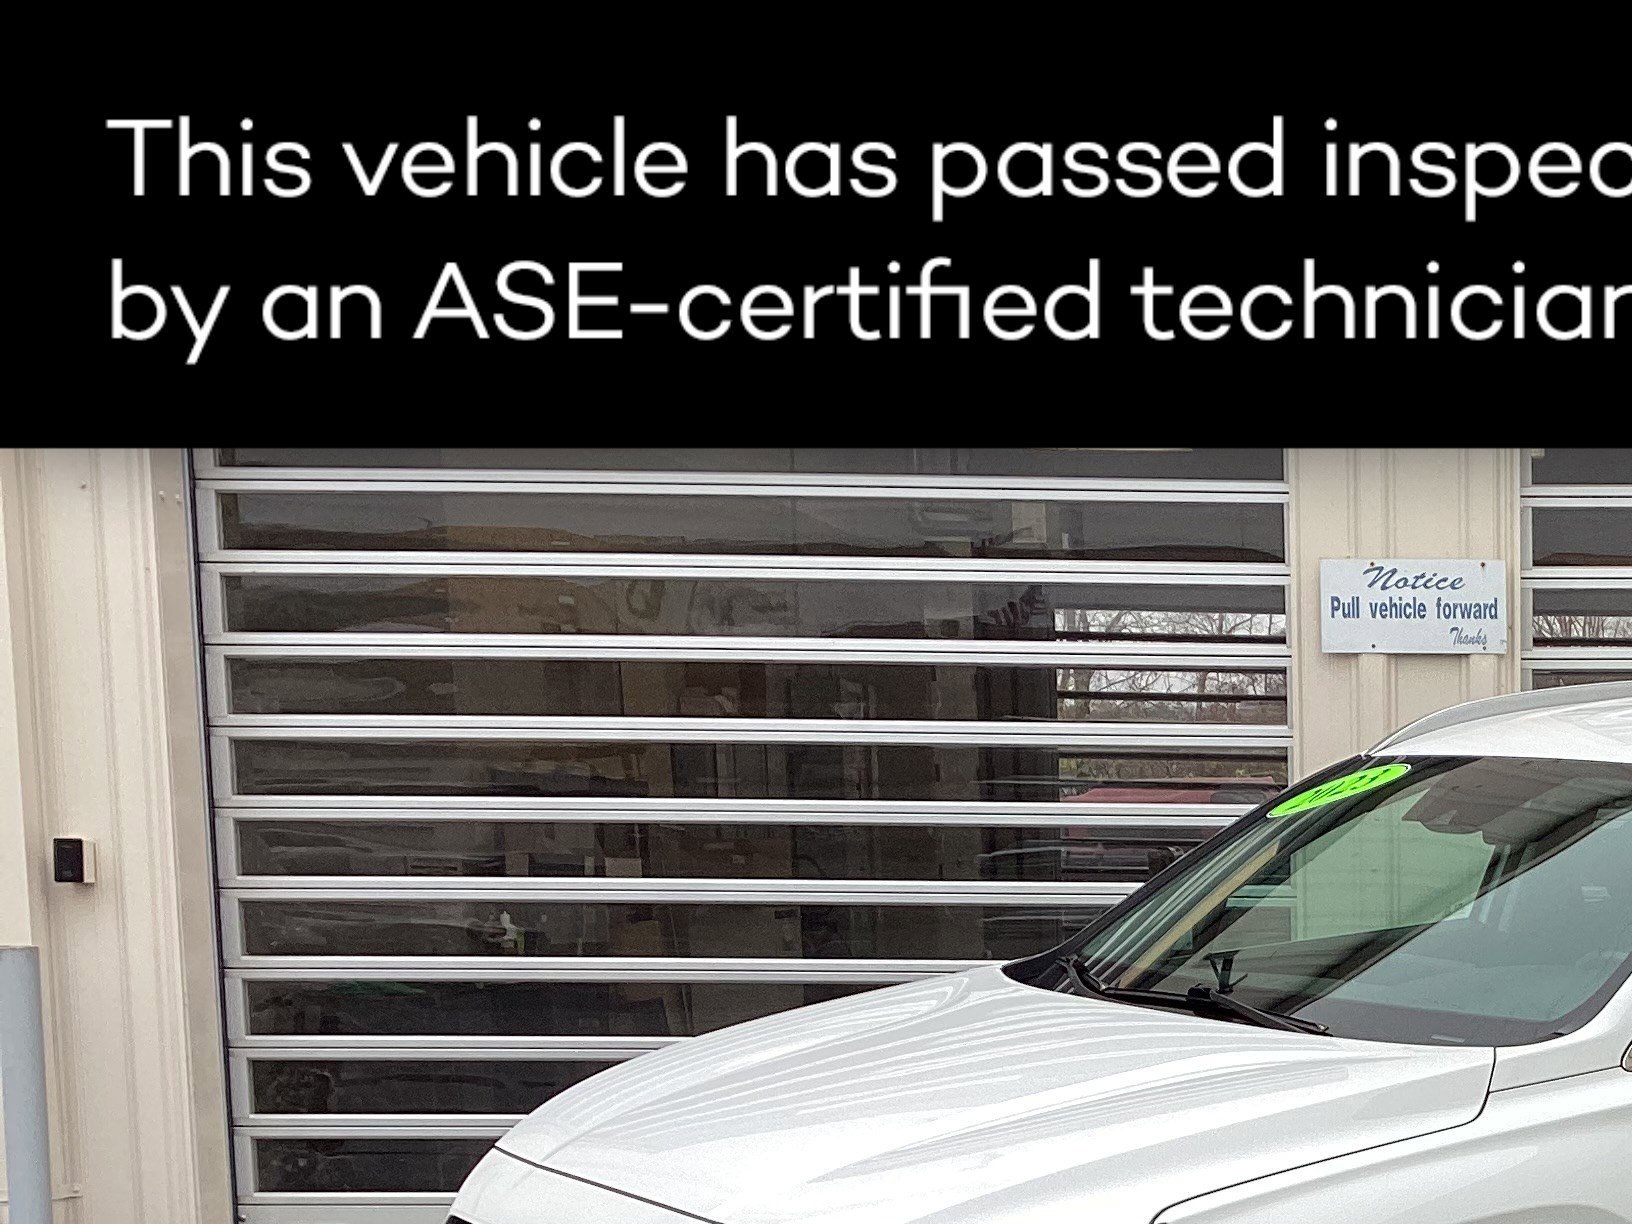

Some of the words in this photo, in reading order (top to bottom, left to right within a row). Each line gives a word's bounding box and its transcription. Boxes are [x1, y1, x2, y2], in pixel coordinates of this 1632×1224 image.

[1362, 565, 1466, 592] Notice
[1330, 595, 1360, 619] Pull
[1369, 596, 1427, 619] vehicle
[1436, 597, 1498, 620] forward
[1450, 626, 1488, 646] Thanks
